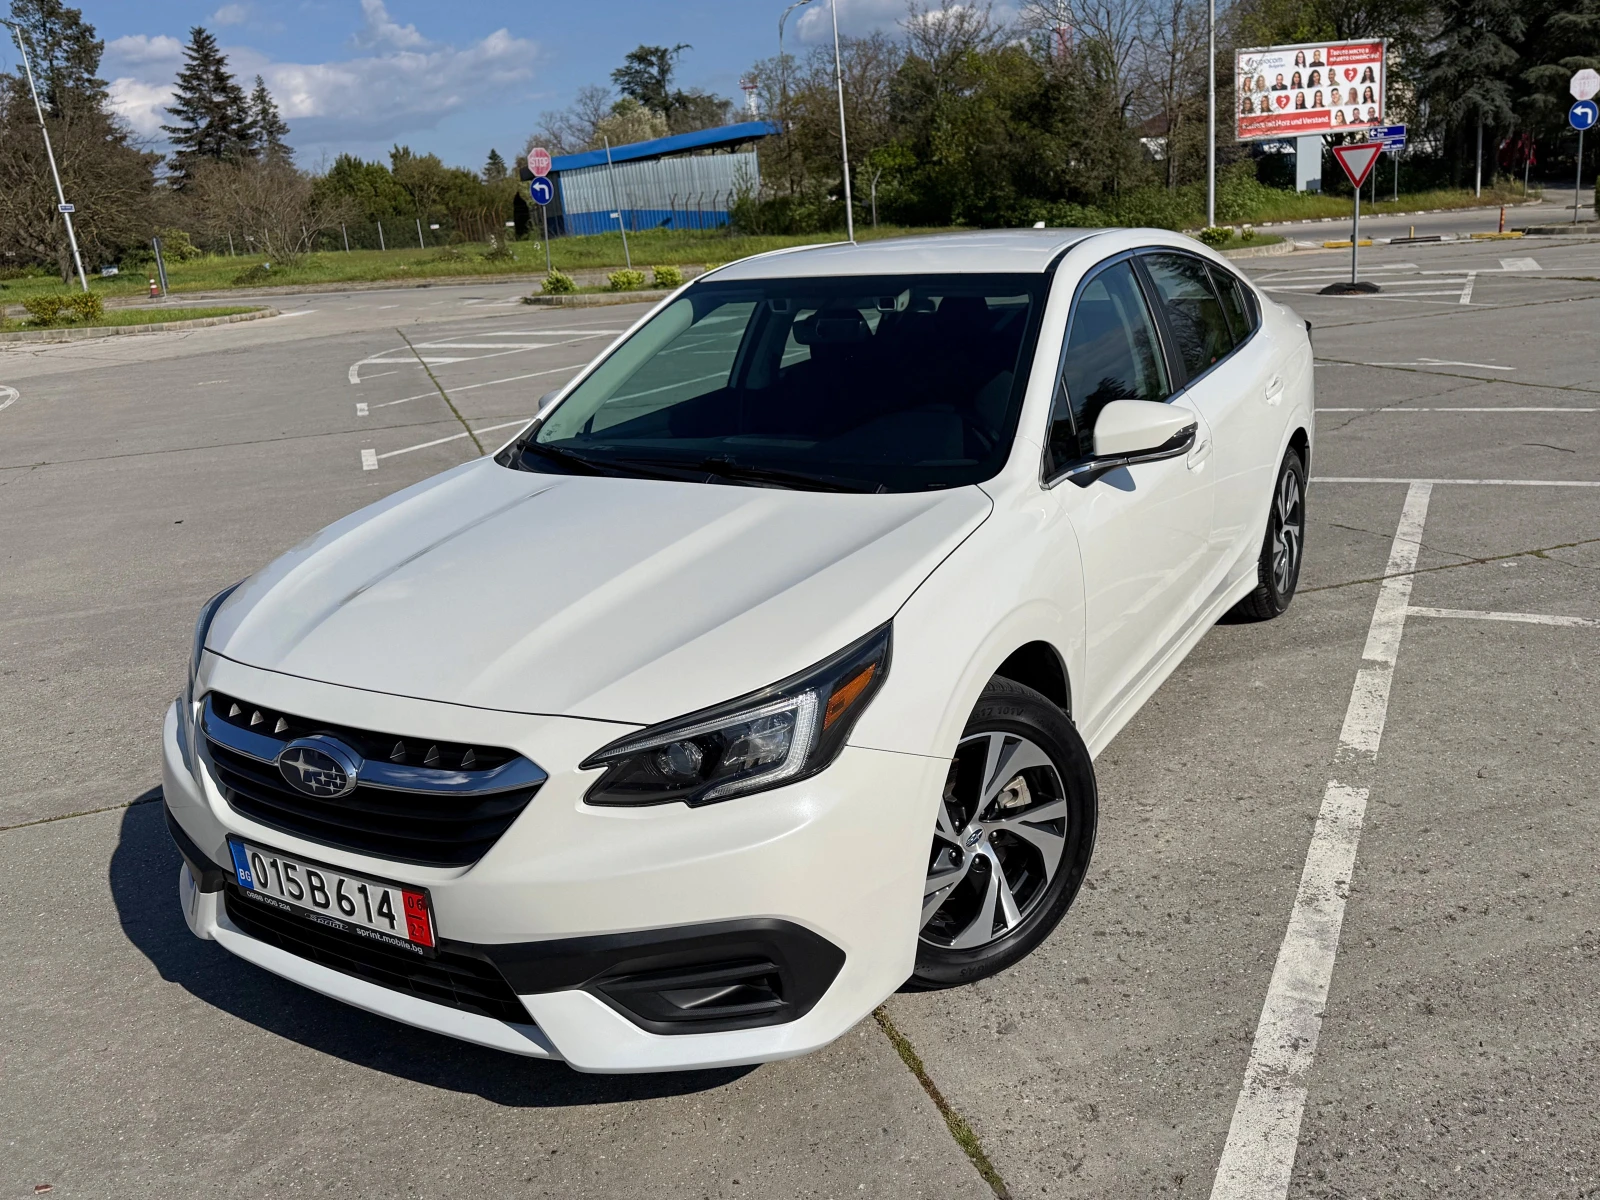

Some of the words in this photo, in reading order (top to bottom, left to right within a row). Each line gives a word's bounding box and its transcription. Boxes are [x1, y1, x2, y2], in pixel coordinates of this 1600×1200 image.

[529, 157, 548, 167] STOP
[997, 706, 1025, 716] 101V
[238, 868, 252, 881] BG
[407, 894, 425, 911] 06
[356, 927, 423, 955] sprint.mobile.bg
